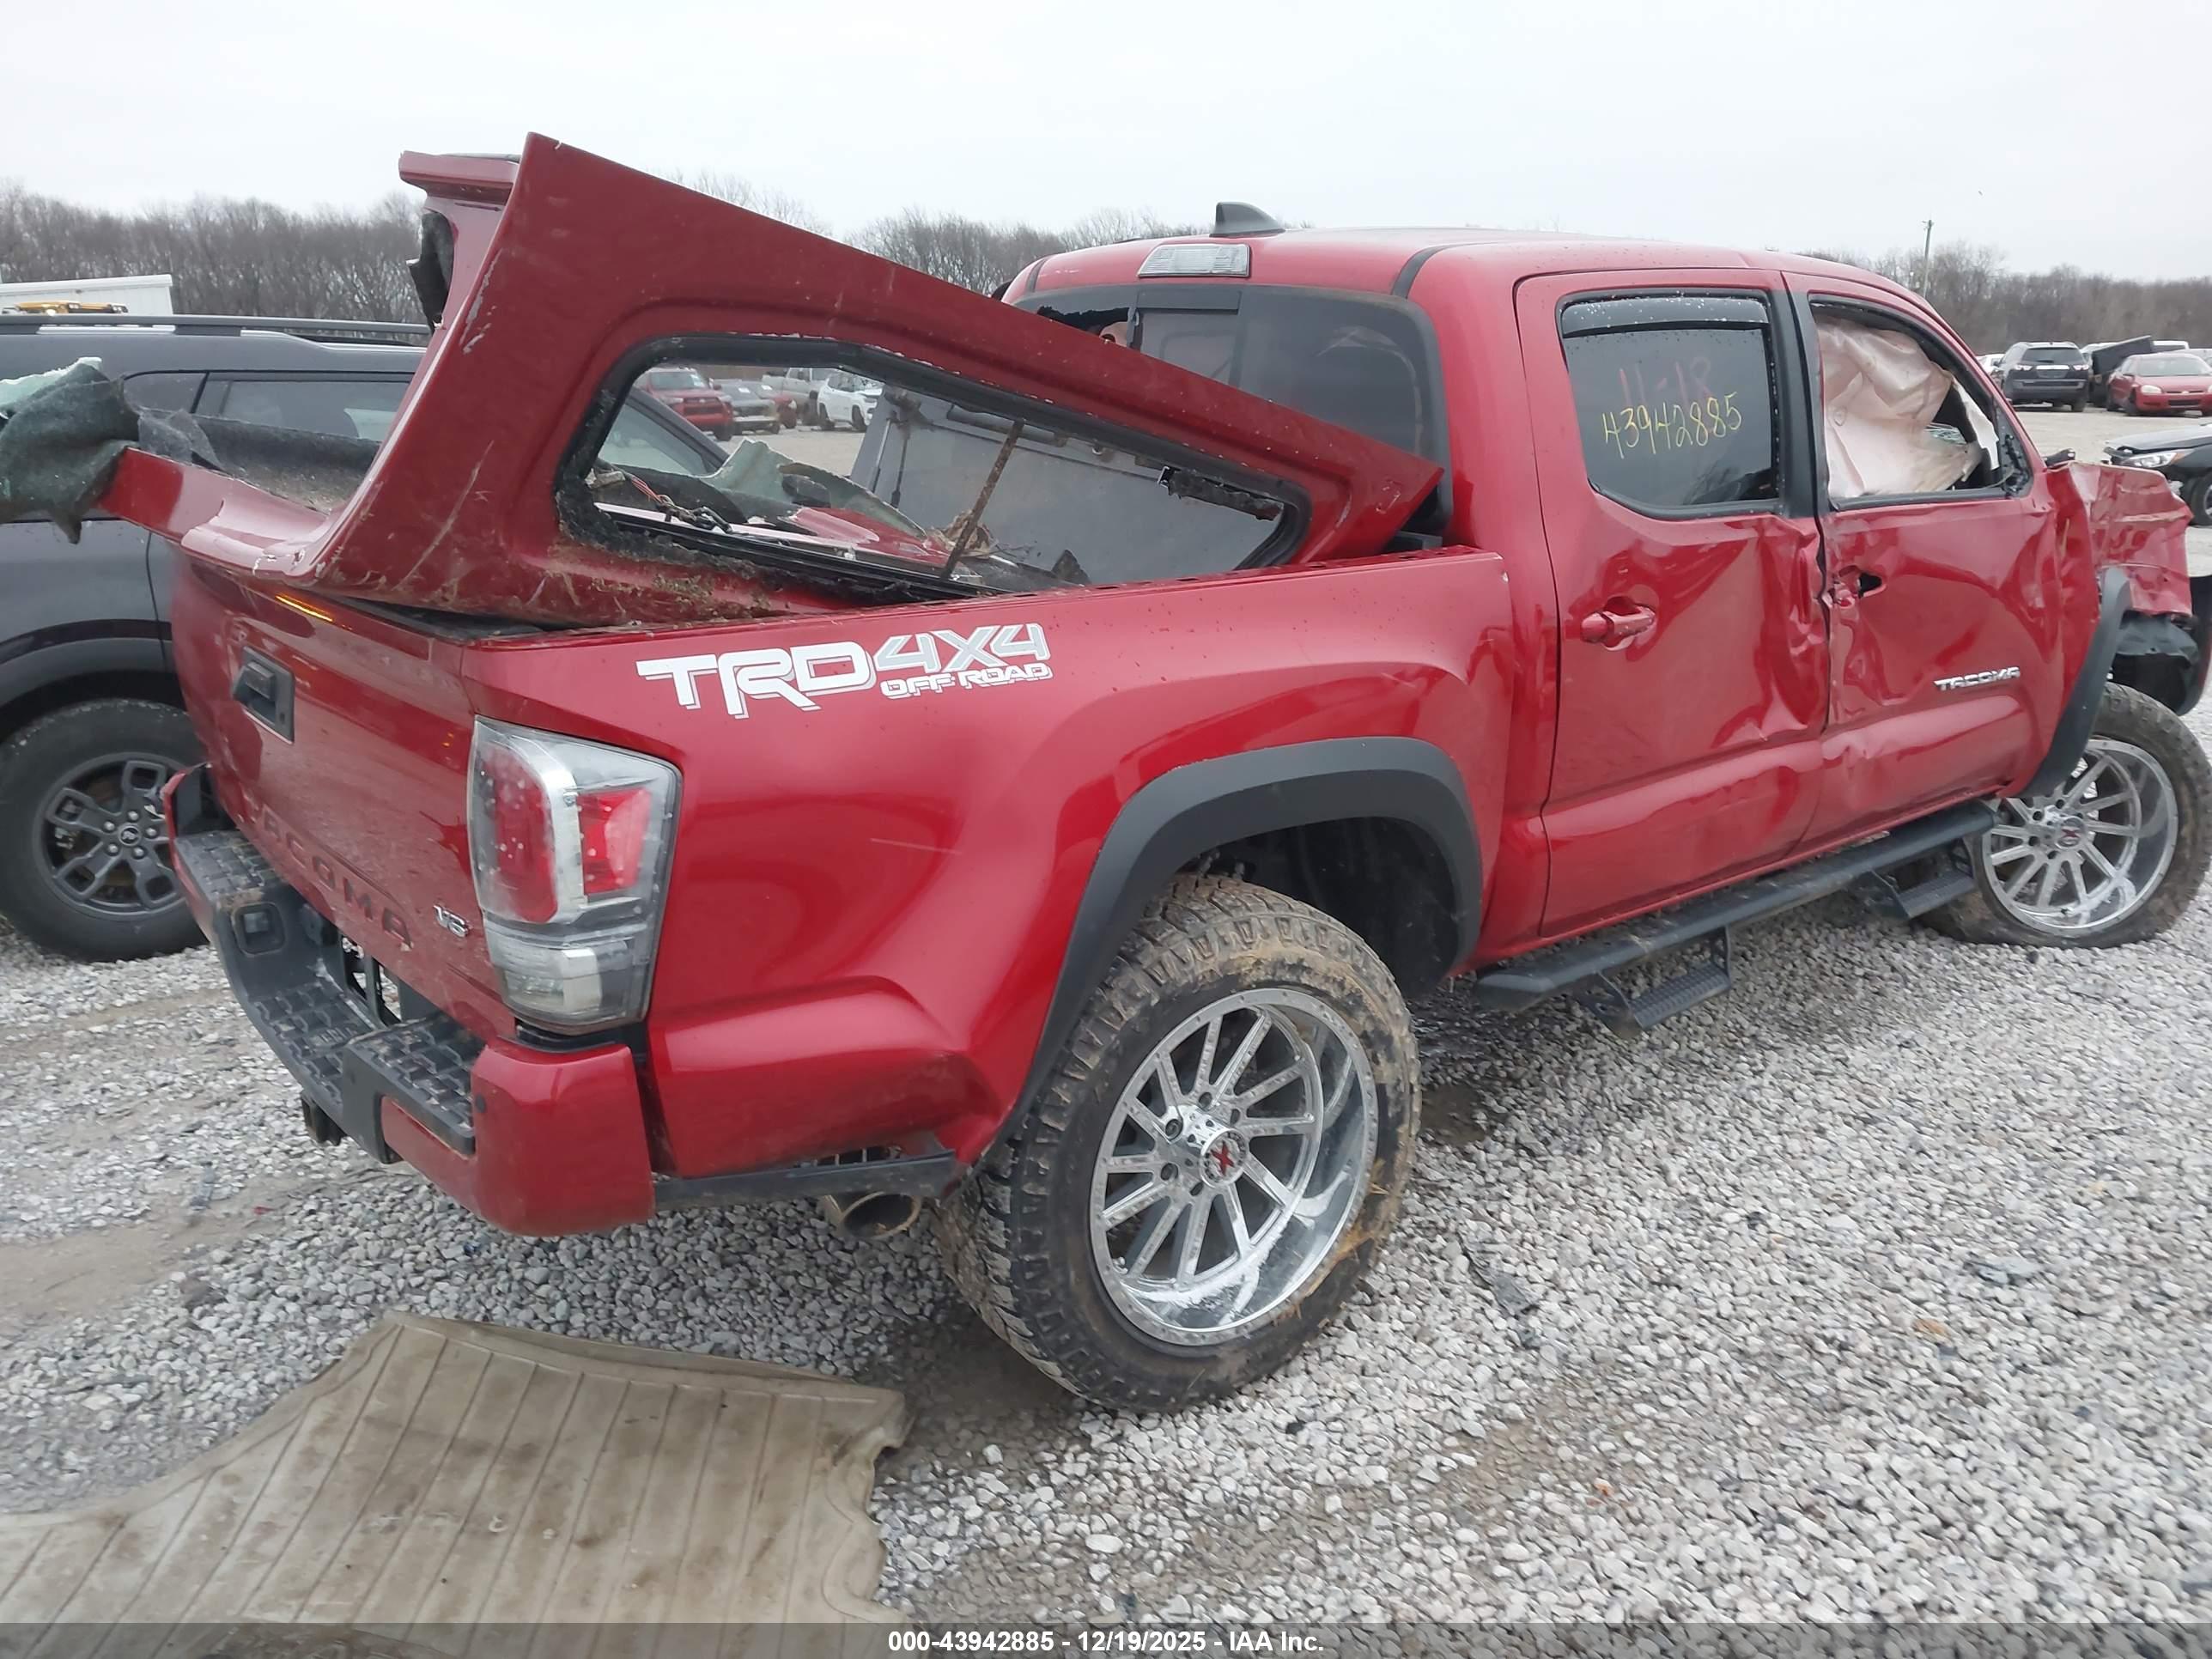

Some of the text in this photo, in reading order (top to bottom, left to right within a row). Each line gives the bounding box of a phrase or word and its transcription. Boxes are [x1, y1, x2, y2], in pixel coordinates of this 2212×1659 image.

[1601, 392, 1742, 459] 43942885
[635, 623, 1051, 719] TRD 4X4
[880, 662, 1054, 700] OFF ROAD
[1933, 666, 2021, 691] TACOMA
[433, 904, 469, 938] V6
